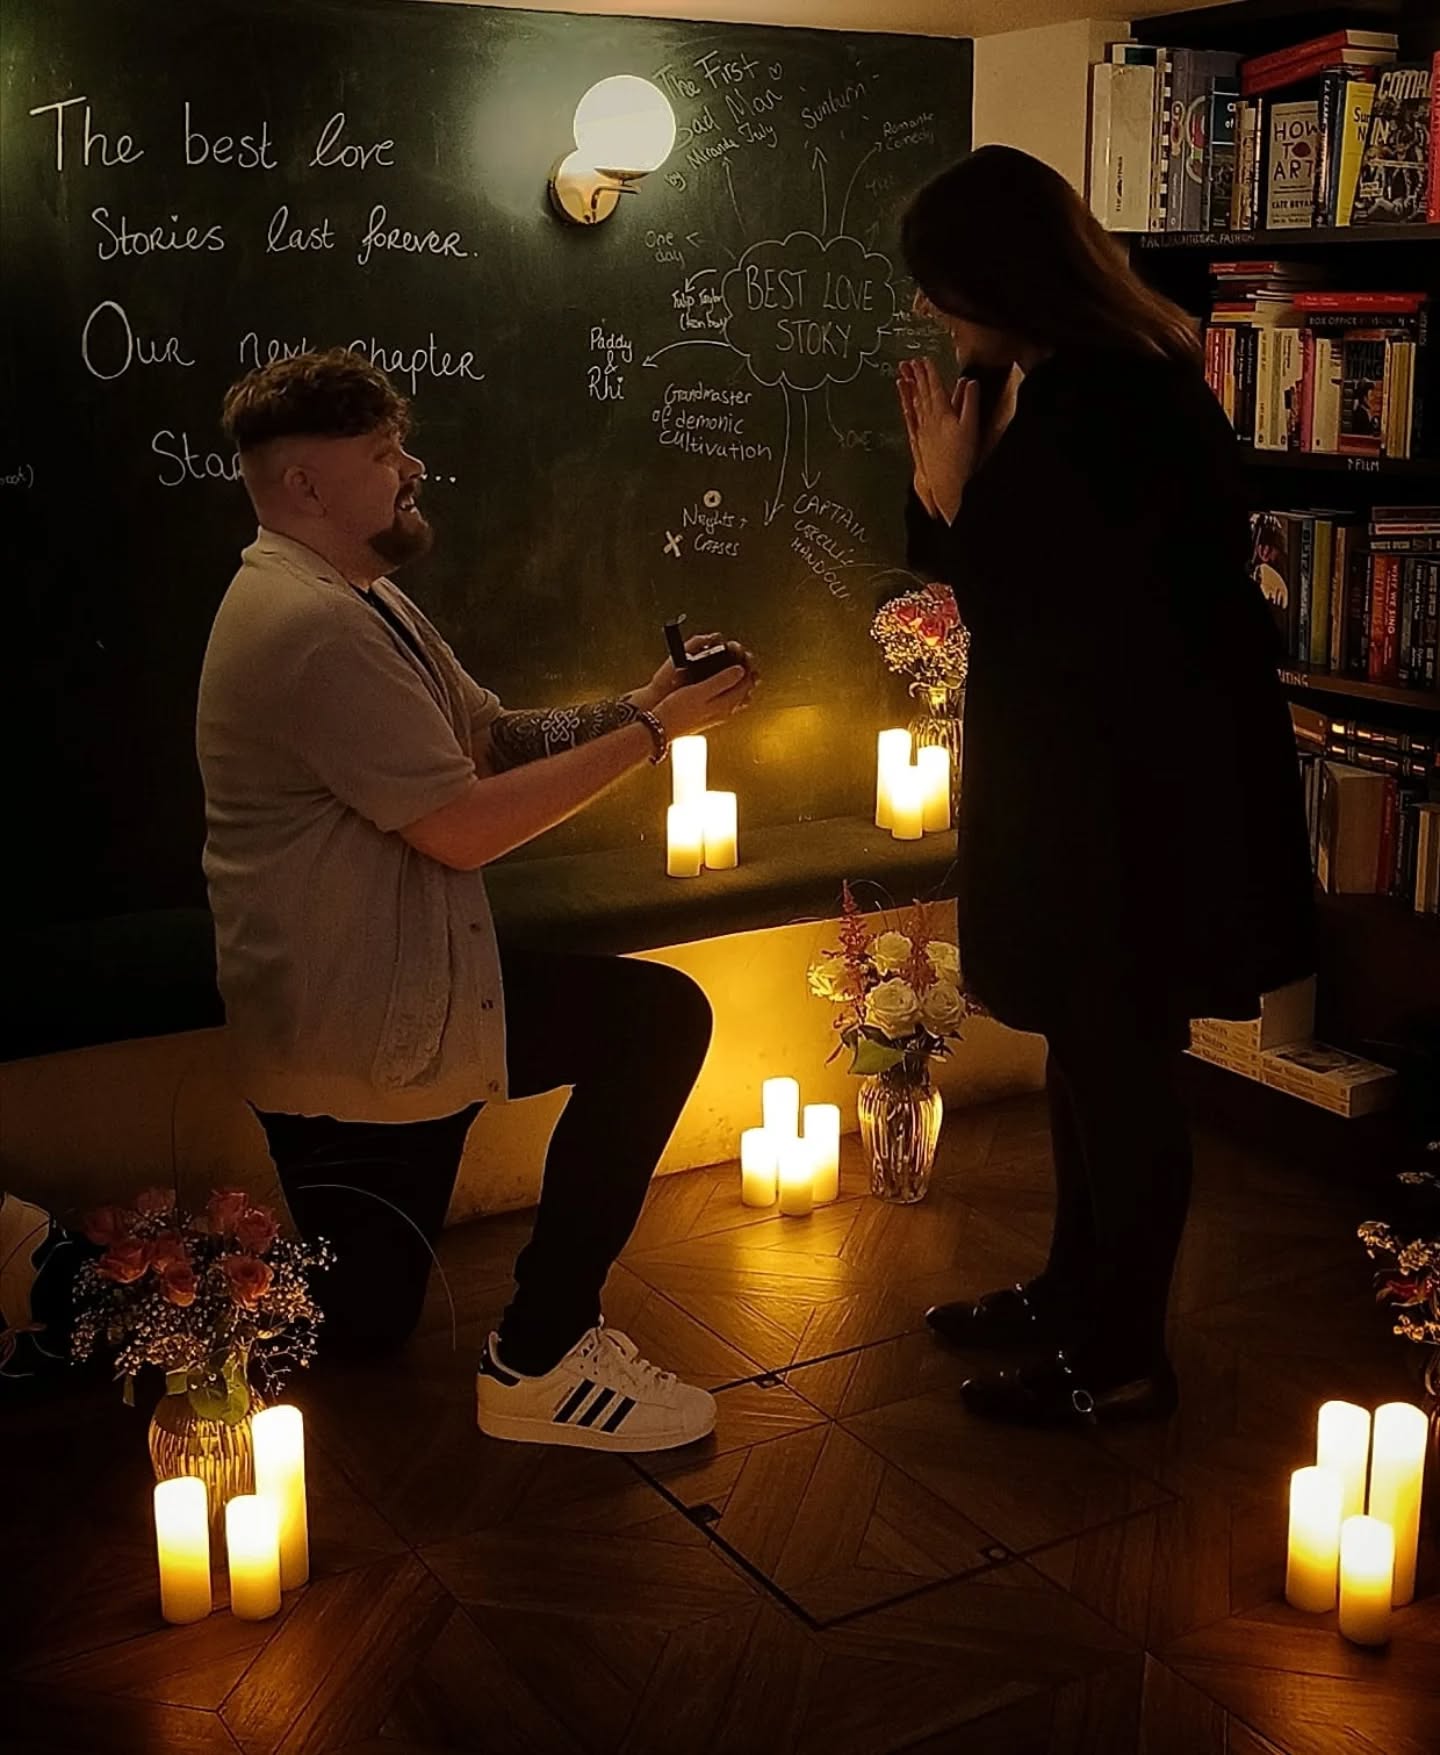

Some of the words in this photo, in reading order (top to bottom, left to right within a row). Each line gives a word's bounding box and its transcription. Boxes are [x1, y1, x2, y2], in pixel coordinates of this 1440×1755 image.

[652, 64, 701, 100] The
[694, 50, 760, 89] First
[724, 88, 783, 125] Man
[29, 96, 144, 171] The
[184, 102, 278, 170] best
[309, 112, 395, 170] love
[686, 137, 740, 170] Miranda
[738, 121, 778, 149] July
[1274, 121, 1318, 141] HOW
[1273, 160, 1314, 181] ART
[91, 206, 225, 261] Stories
[265, 205, 335, 253] last
[644, 230, 675, 249] One
[653, 248, 686, 268] day
[746, 264, 808, 311] BEST
[822, 271, 874, 311] LOVE
[81, 301, 196, 381] Our
[590, 326, 634, 361] Paddy
[775, 318, 852, 359] STORY
[663, 381, 753, 405] Grandmaster
[652, 407, 672, 431] of
[675, 410, 745, 435] demonic
[793, 494, 867, 543] CAPTAIN
